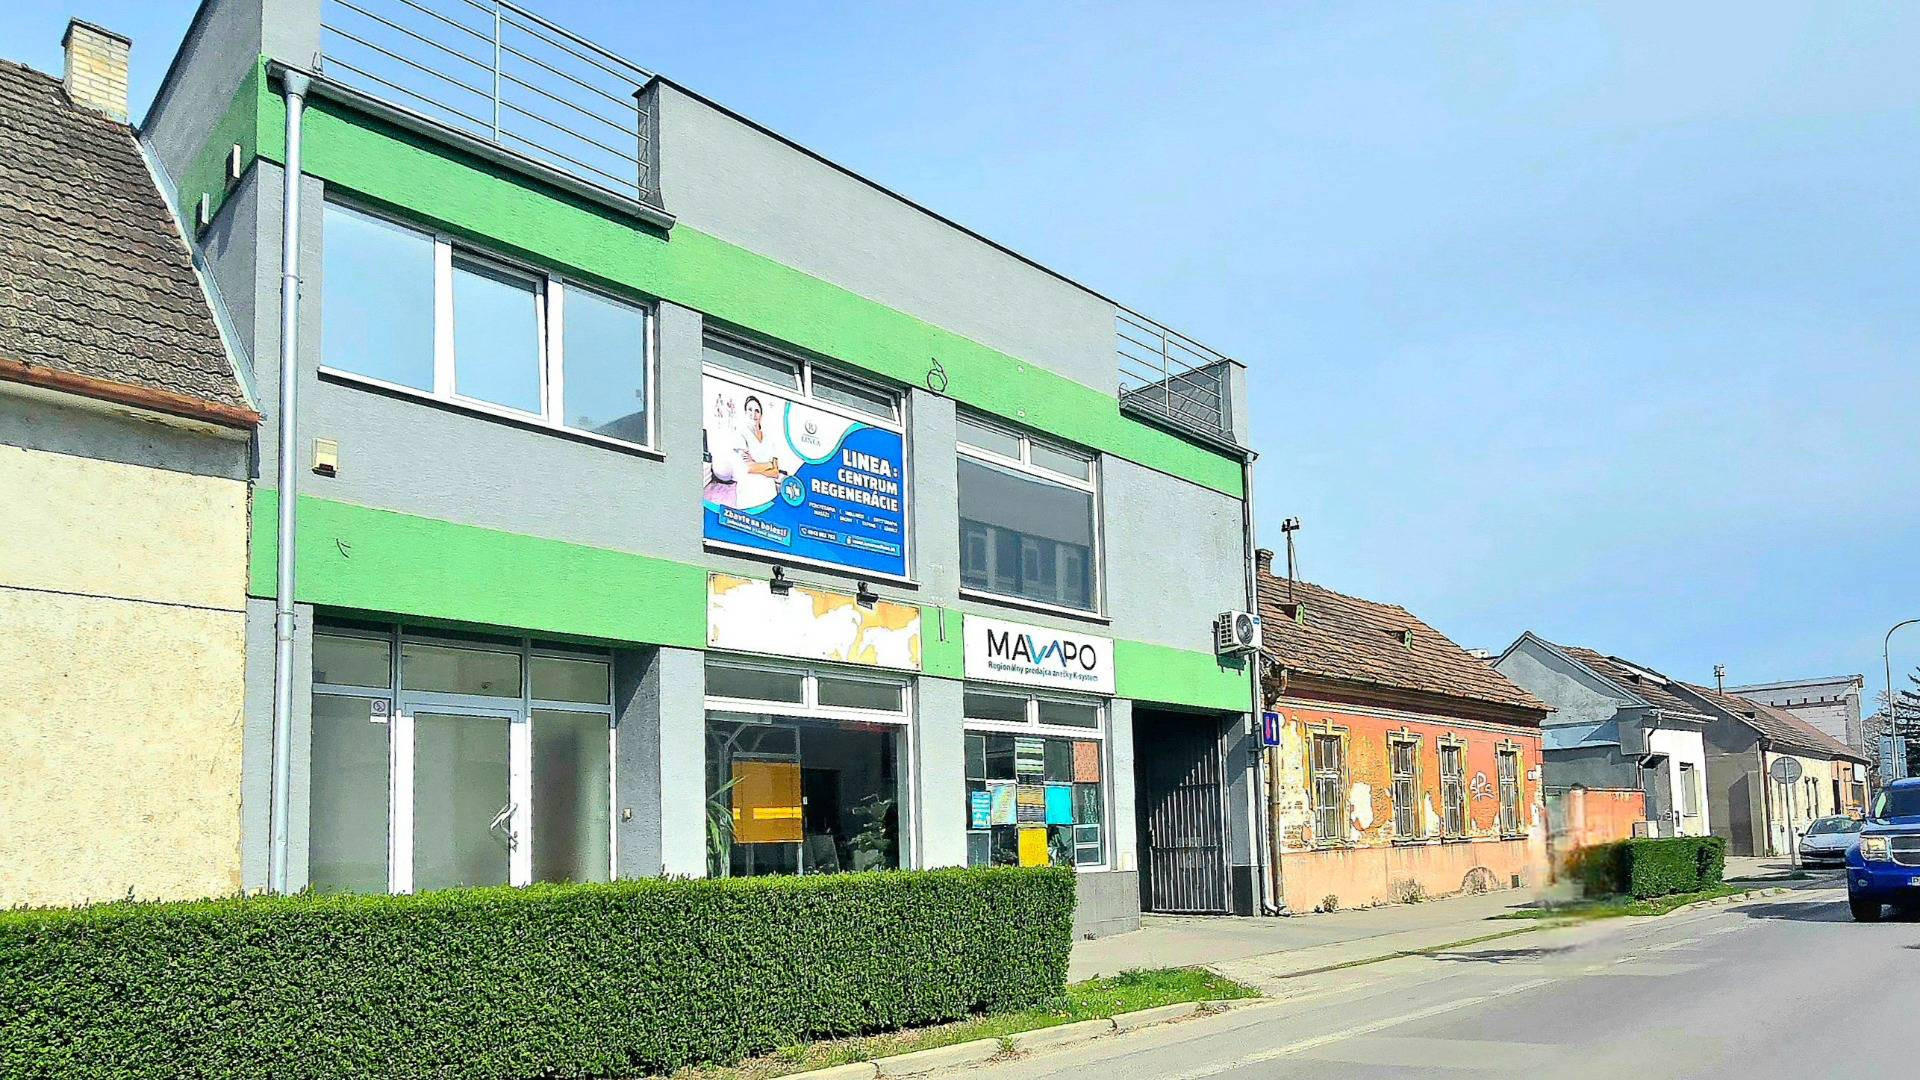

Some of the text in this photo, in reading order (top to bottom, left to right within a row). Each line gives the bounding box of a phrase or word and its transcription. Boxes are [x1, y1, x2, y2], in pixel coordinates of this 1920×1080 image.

[811, 478, 899, 512] REGENERÁCIE
[838, 468, 898, 495] CENTRUM
[987, 628, 1097, 671] MAVAPO
[988, 660, 1024, 674] Regionálny
[1025, 666, 1051, 677] predajca
